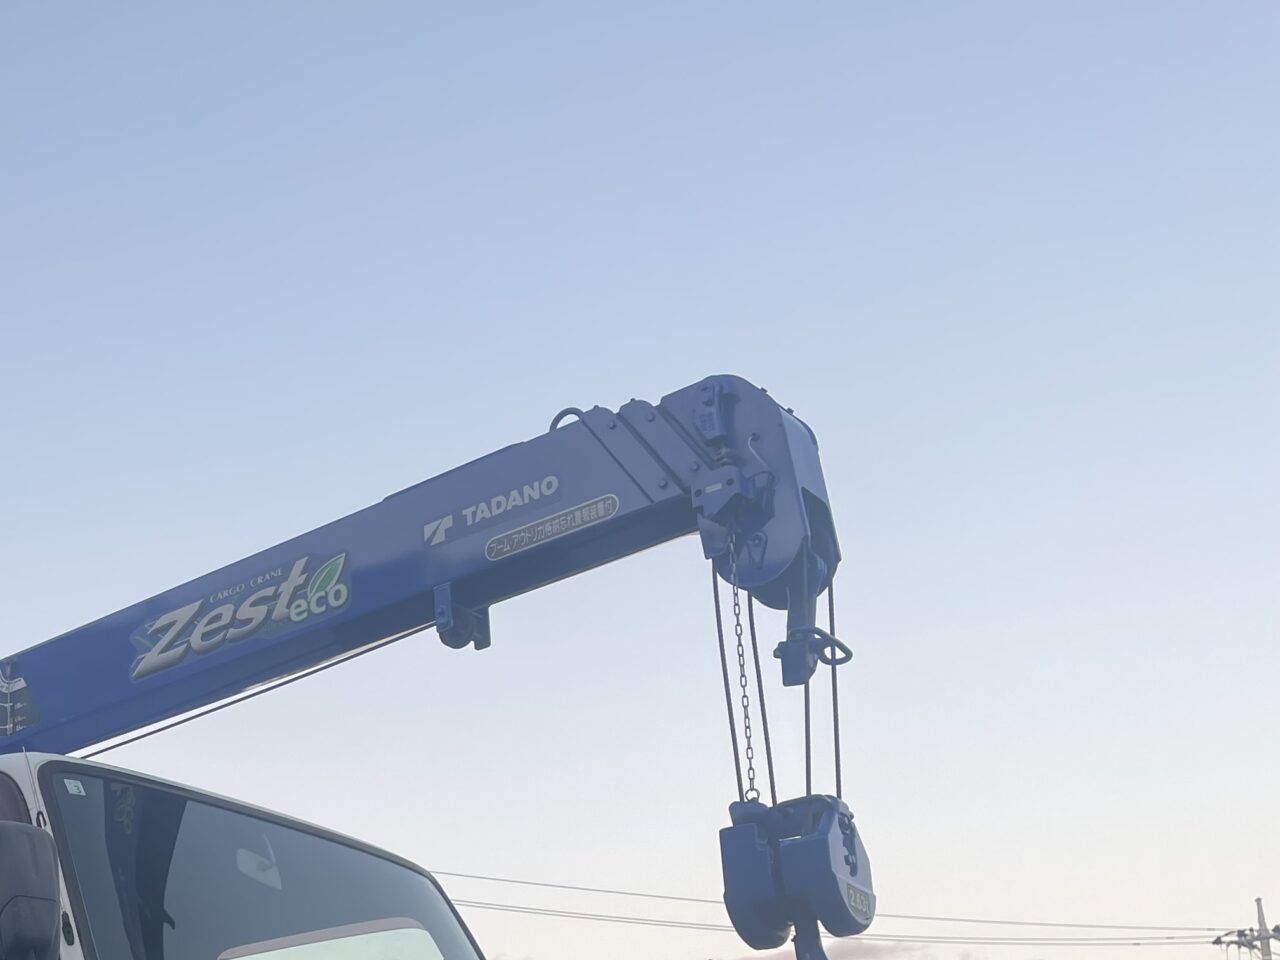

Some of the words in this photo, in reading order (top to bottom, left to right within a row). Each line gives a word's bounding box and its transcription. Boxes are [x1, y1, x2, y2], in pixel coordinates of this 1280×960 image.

[462, 475, 559, 526] TADANO
[209, 583, 245, 603] CARGO
[250, 568, 285, 588] CRANE
[289, 582, 349, 622] eco
[130, 556, 310, 680] Zest
